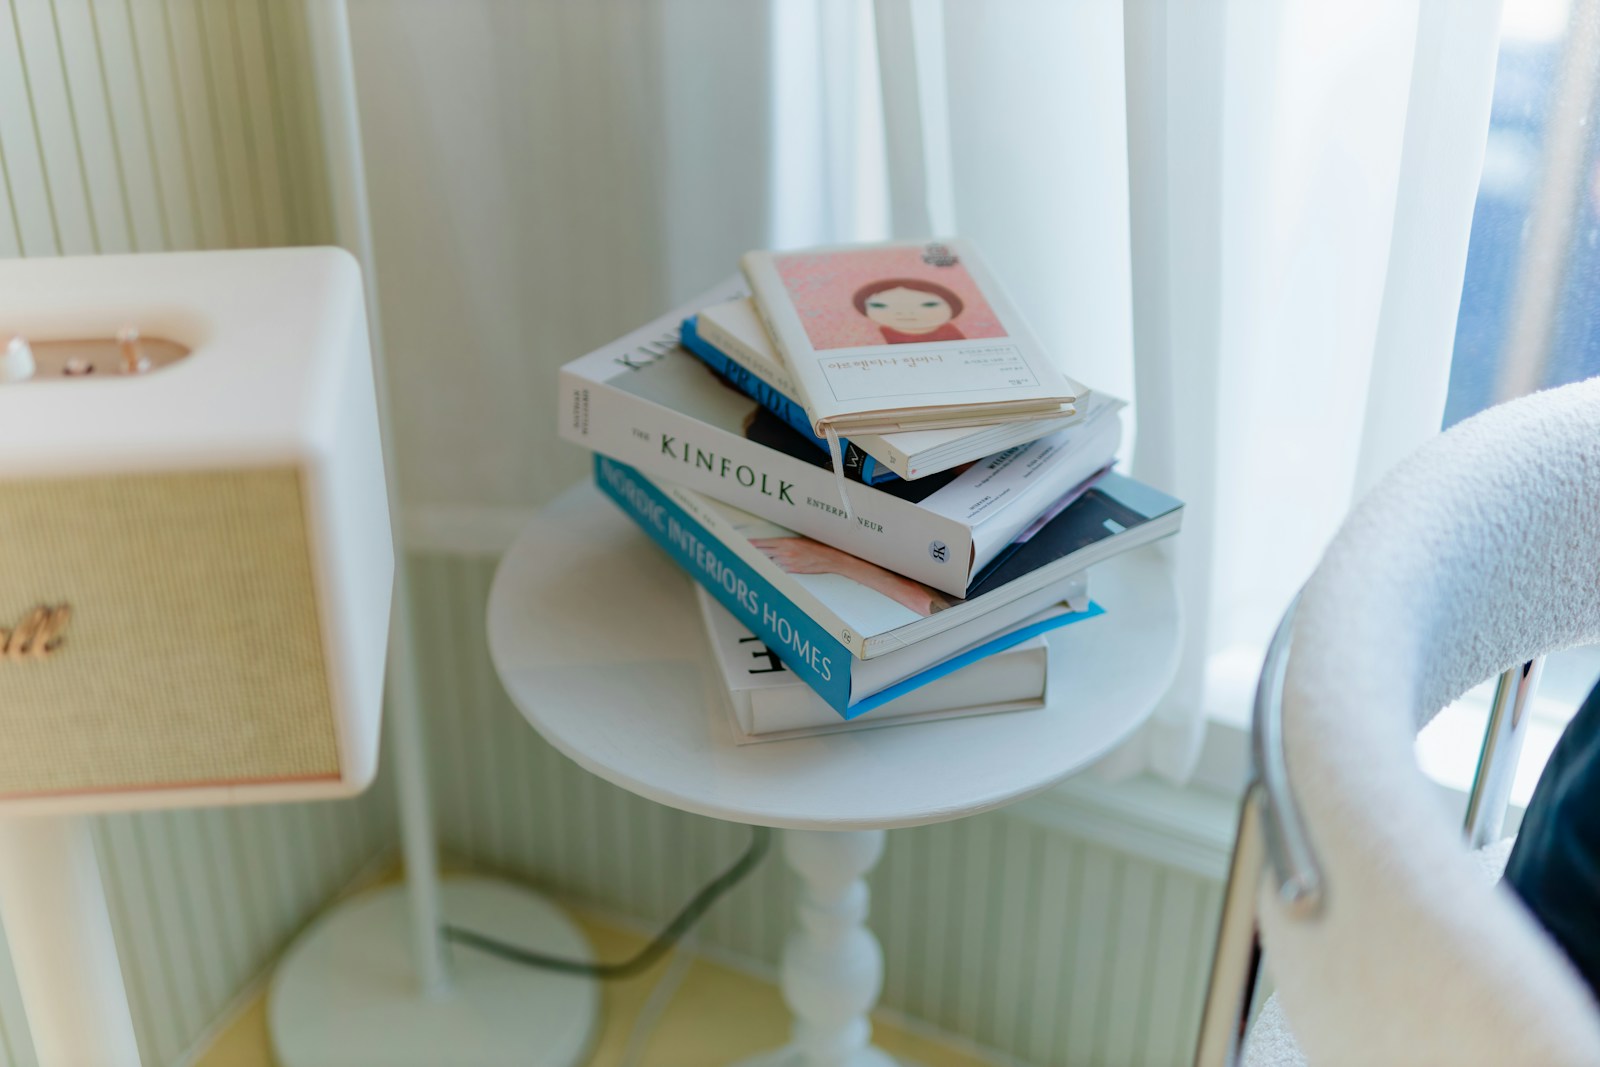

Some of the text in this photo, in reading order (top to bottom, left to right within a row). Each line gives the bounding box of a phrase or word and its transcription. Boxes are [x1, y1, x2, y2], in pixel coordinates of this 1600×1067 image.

[661, 433, 795, 505] KINFOLK
[601, 459, 667, 533] NORDIC
[668, 516, 759, 615] INTERIORS
[763, 602, 832, 681] HOMES
